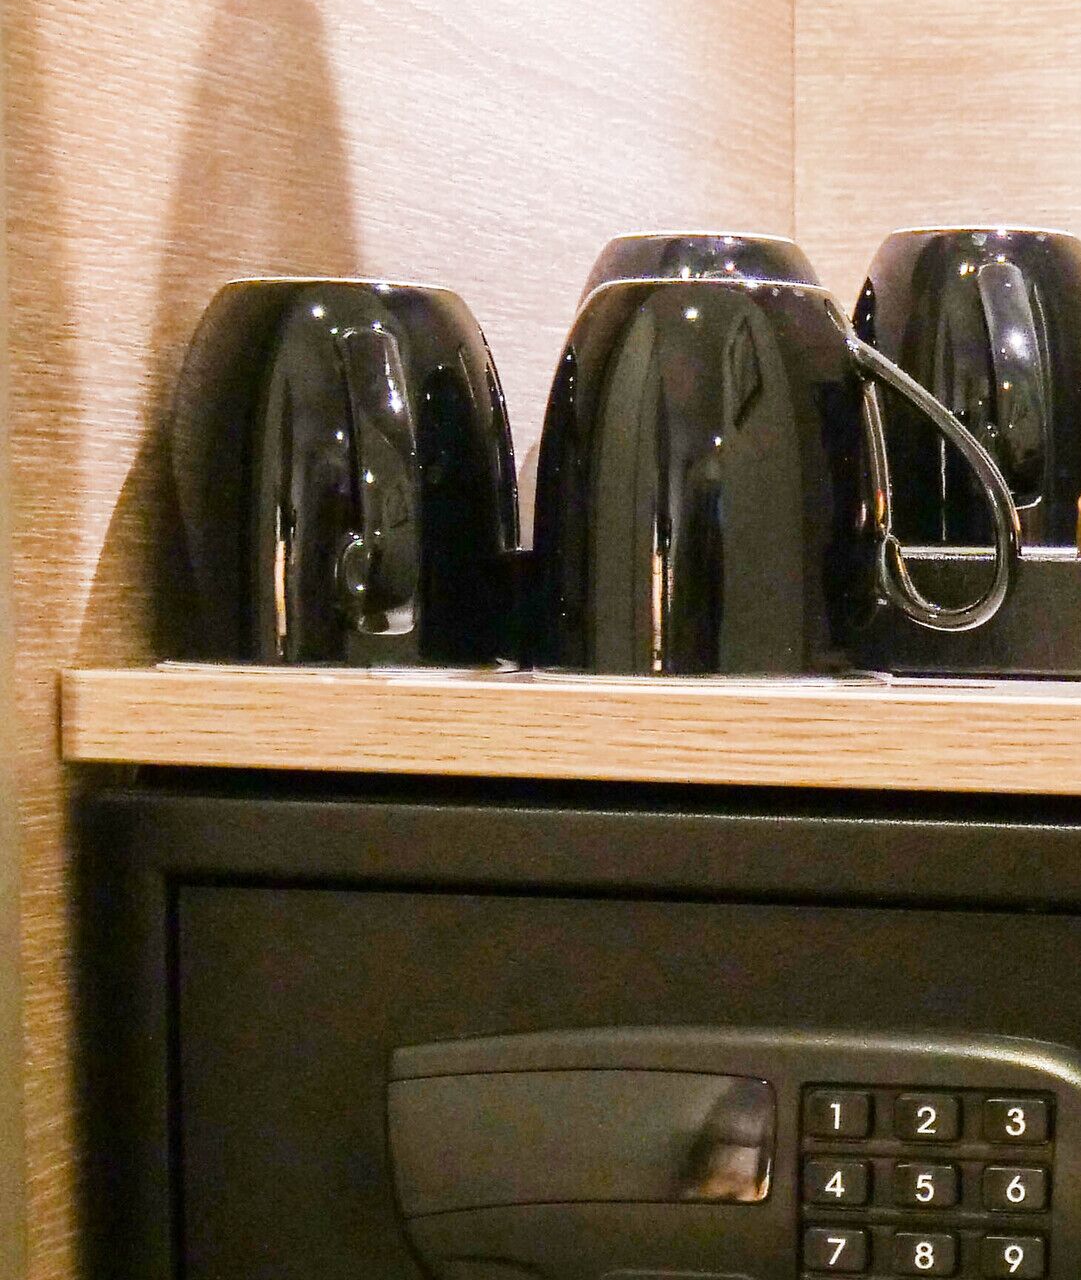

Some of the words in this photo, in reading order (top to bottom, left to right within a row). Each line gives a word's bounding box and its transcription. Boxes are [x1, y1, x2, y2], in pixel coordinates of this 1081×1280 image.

[829, 1104, 842, 1130] 1
[917, 1106, 938, 1134] 2
[1006, 1108, 1027, 1136] 3
[824, 1170, 845, 1198] 4
[915, 1174, 935, 1202] 5
[1006, 1175, 1026, 1203] 6
[828, 1239, 846, 1266] 7
[914, 1241, 935, 1270] 8
[1004, 1245, 1024, 1273] 9
